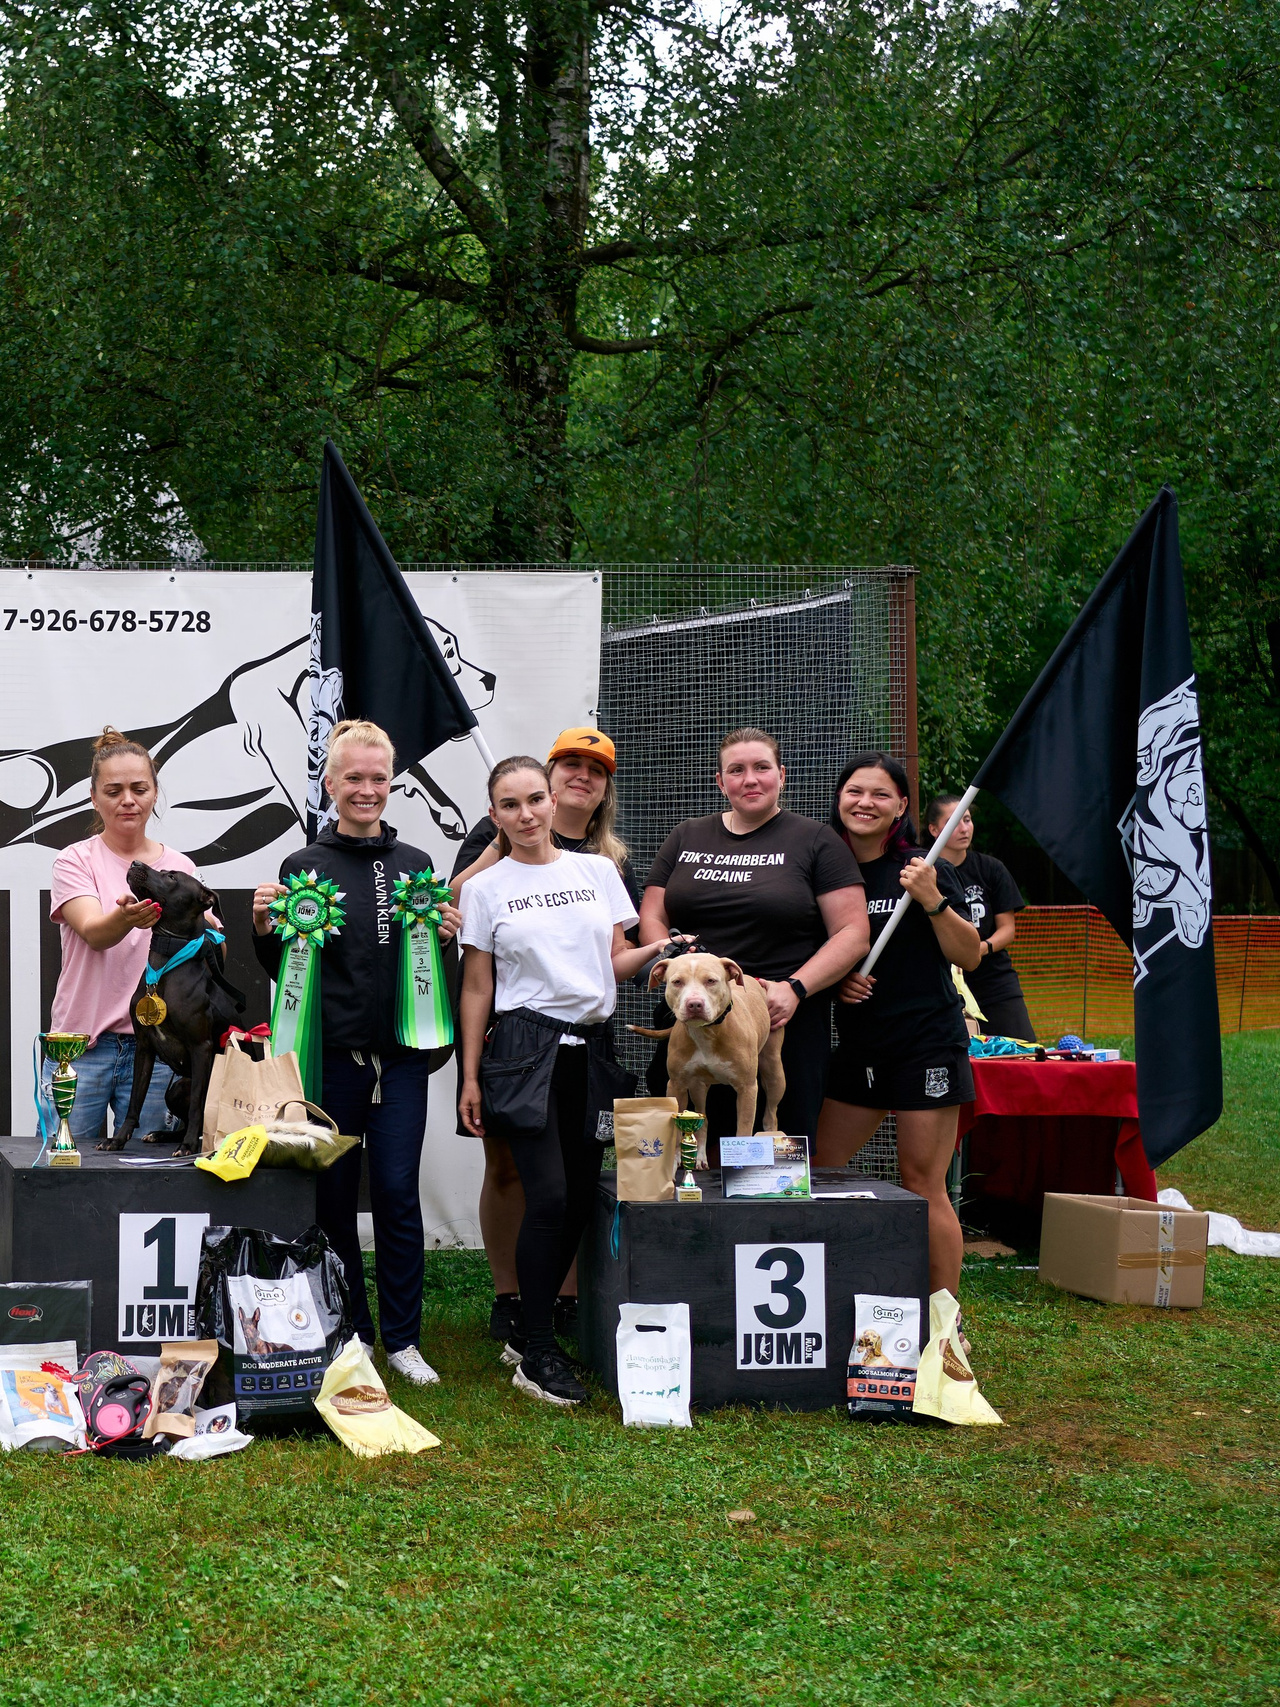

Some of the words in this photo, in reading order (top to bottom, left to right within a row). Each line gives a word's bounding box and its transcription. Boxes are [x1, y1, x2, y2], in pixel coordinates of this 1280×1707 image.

[678, 850, 714, 864] FDK'S
[713, 853, 785, 866] CARIBBEAN
[372, 860, 388, 905] CALVIN
[693, 868, 753, 882] COCAINE
[507, 894, 543, 914] FDK'S
[544, 889, 596, 907] ECSTASY
[865, 898, 901, 915] BELL
[376, 907, 390, 944] KLEIN
[143, 1217, 189, 1300] 1
[753, 1247, 807, 1329] 3
[876, 1309, 899, 1318] Gina
[740, 1332, 823, 1365] JUMP
[258, 1359, 297, 1370] MODERATE
[298, 1356, 322, 1366] ACTIVE
